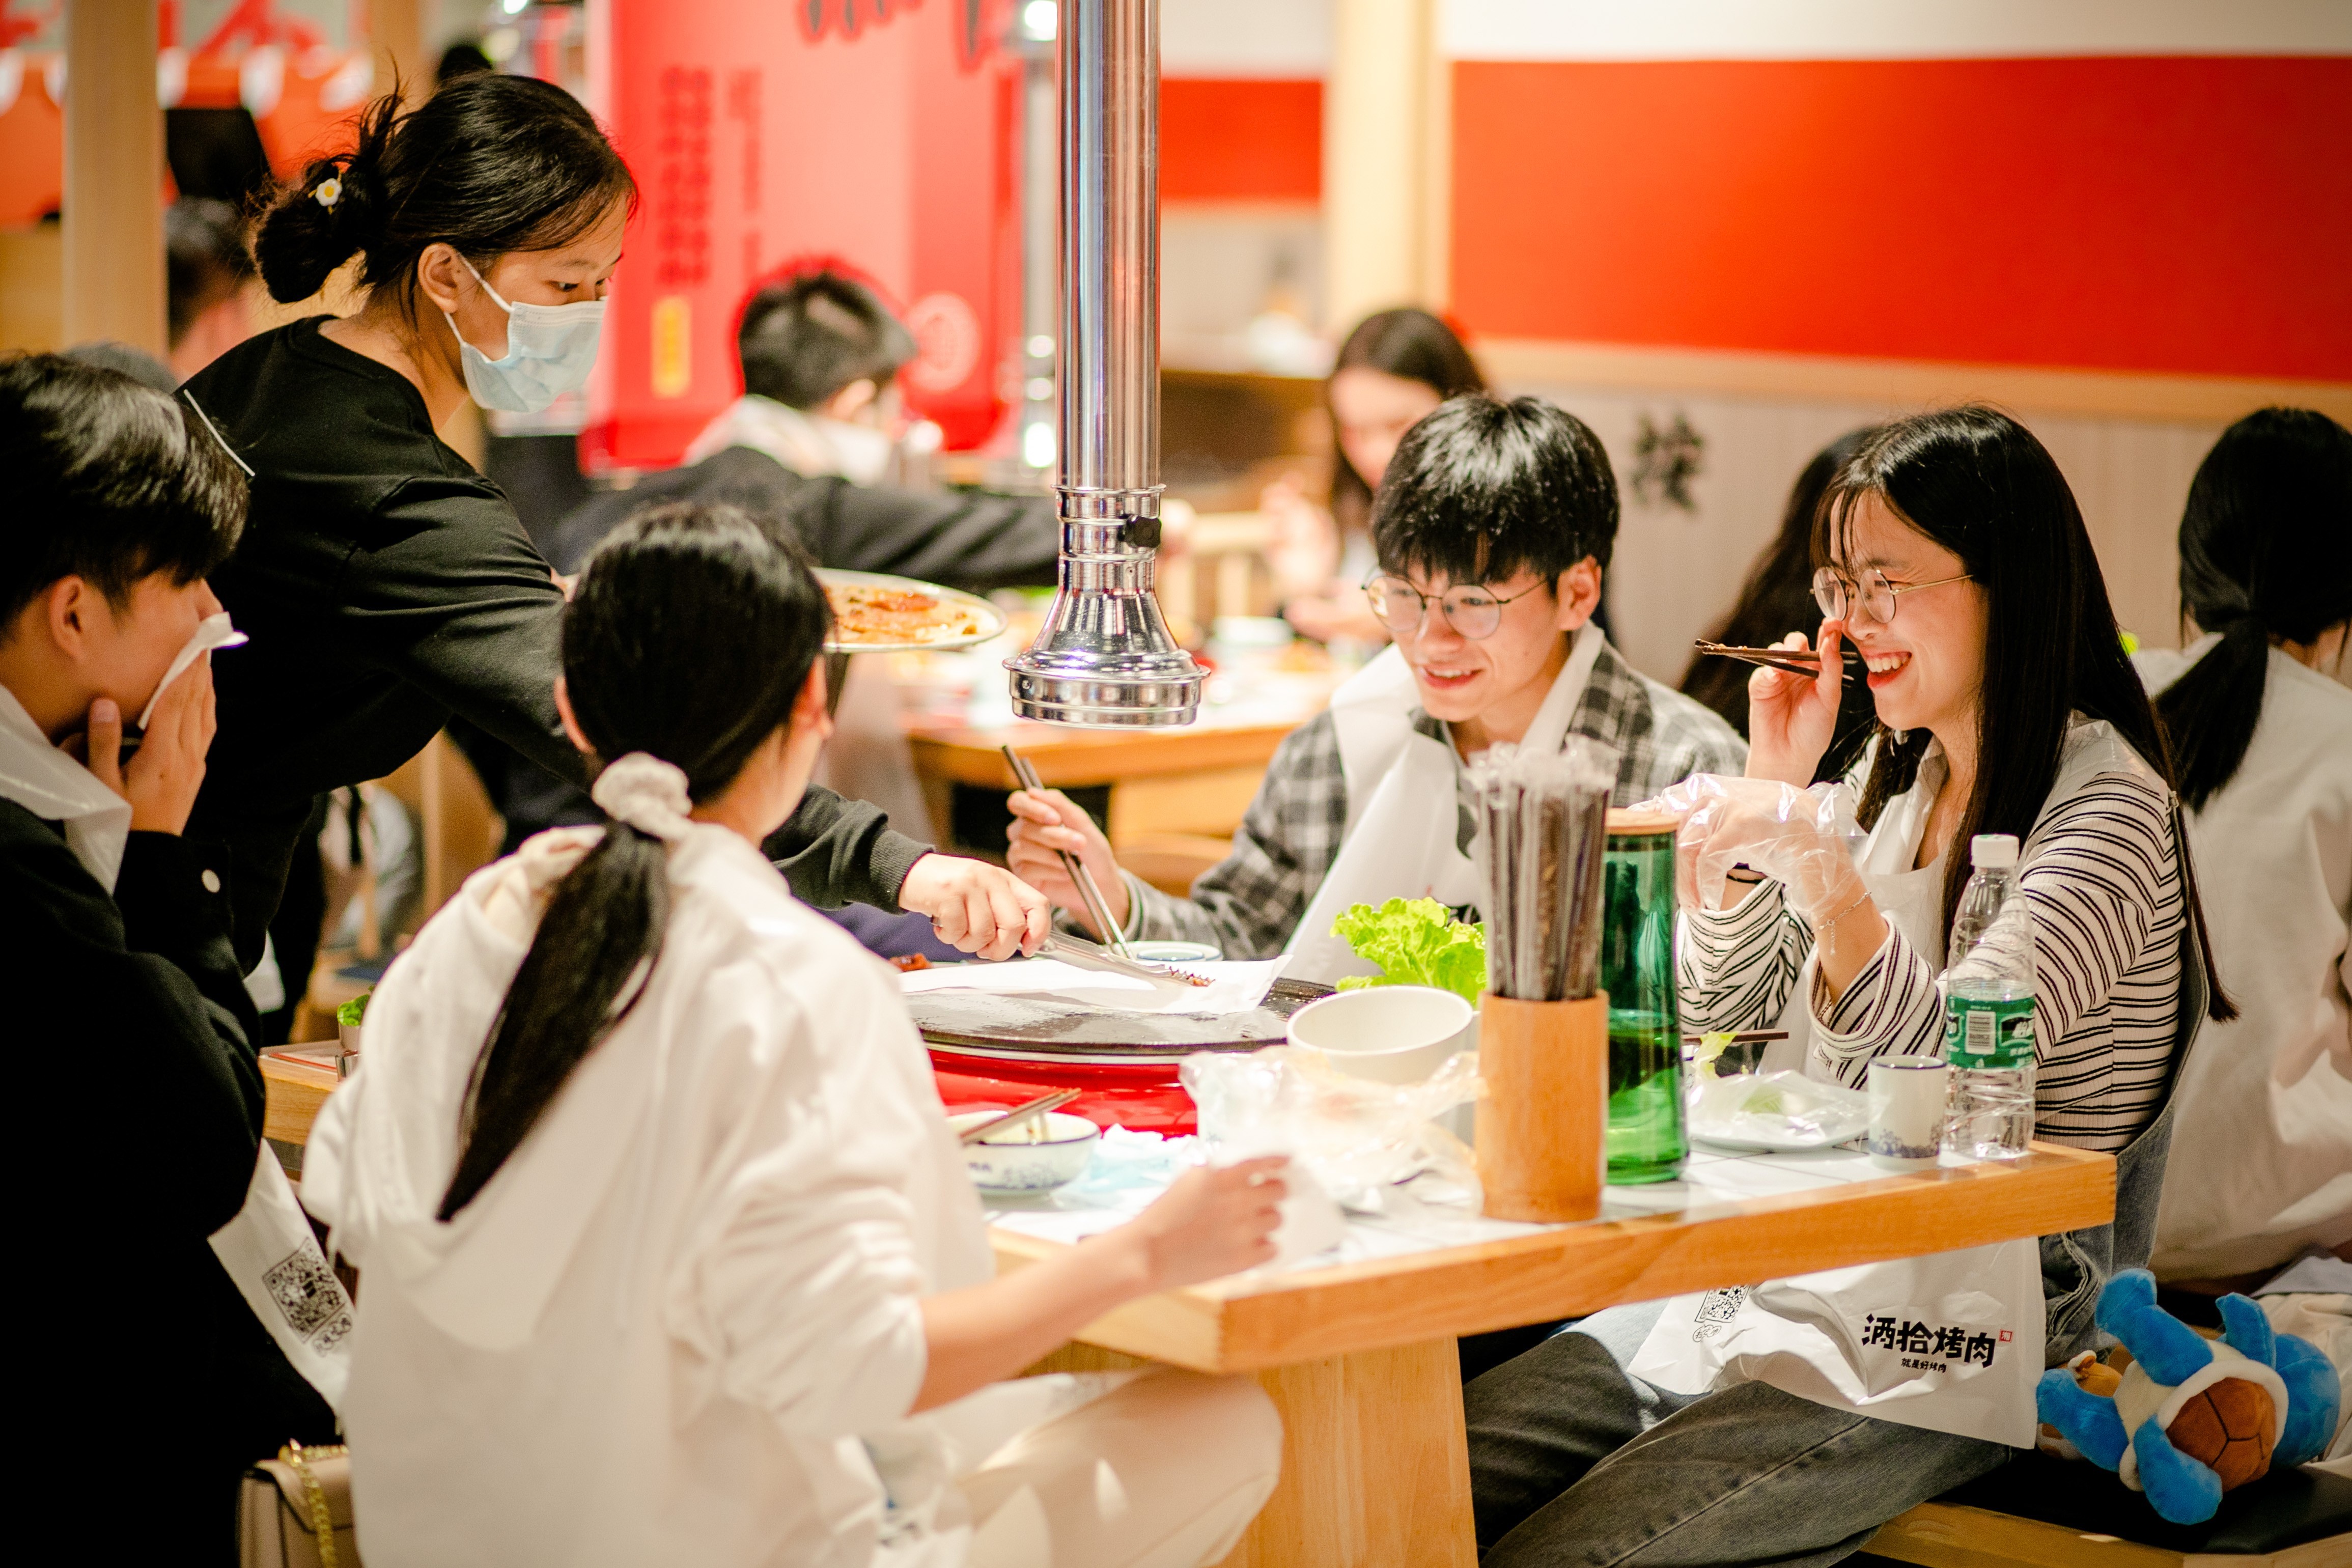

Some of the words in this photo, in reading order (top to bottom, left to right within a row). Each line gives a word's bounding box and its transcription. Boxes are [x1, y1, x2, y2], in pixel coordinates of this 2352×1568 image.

[1862, 1313, 1996, 1368] 酒拾烤肉
[1901, 1358, 1947, 1373] 就是好烤肉
